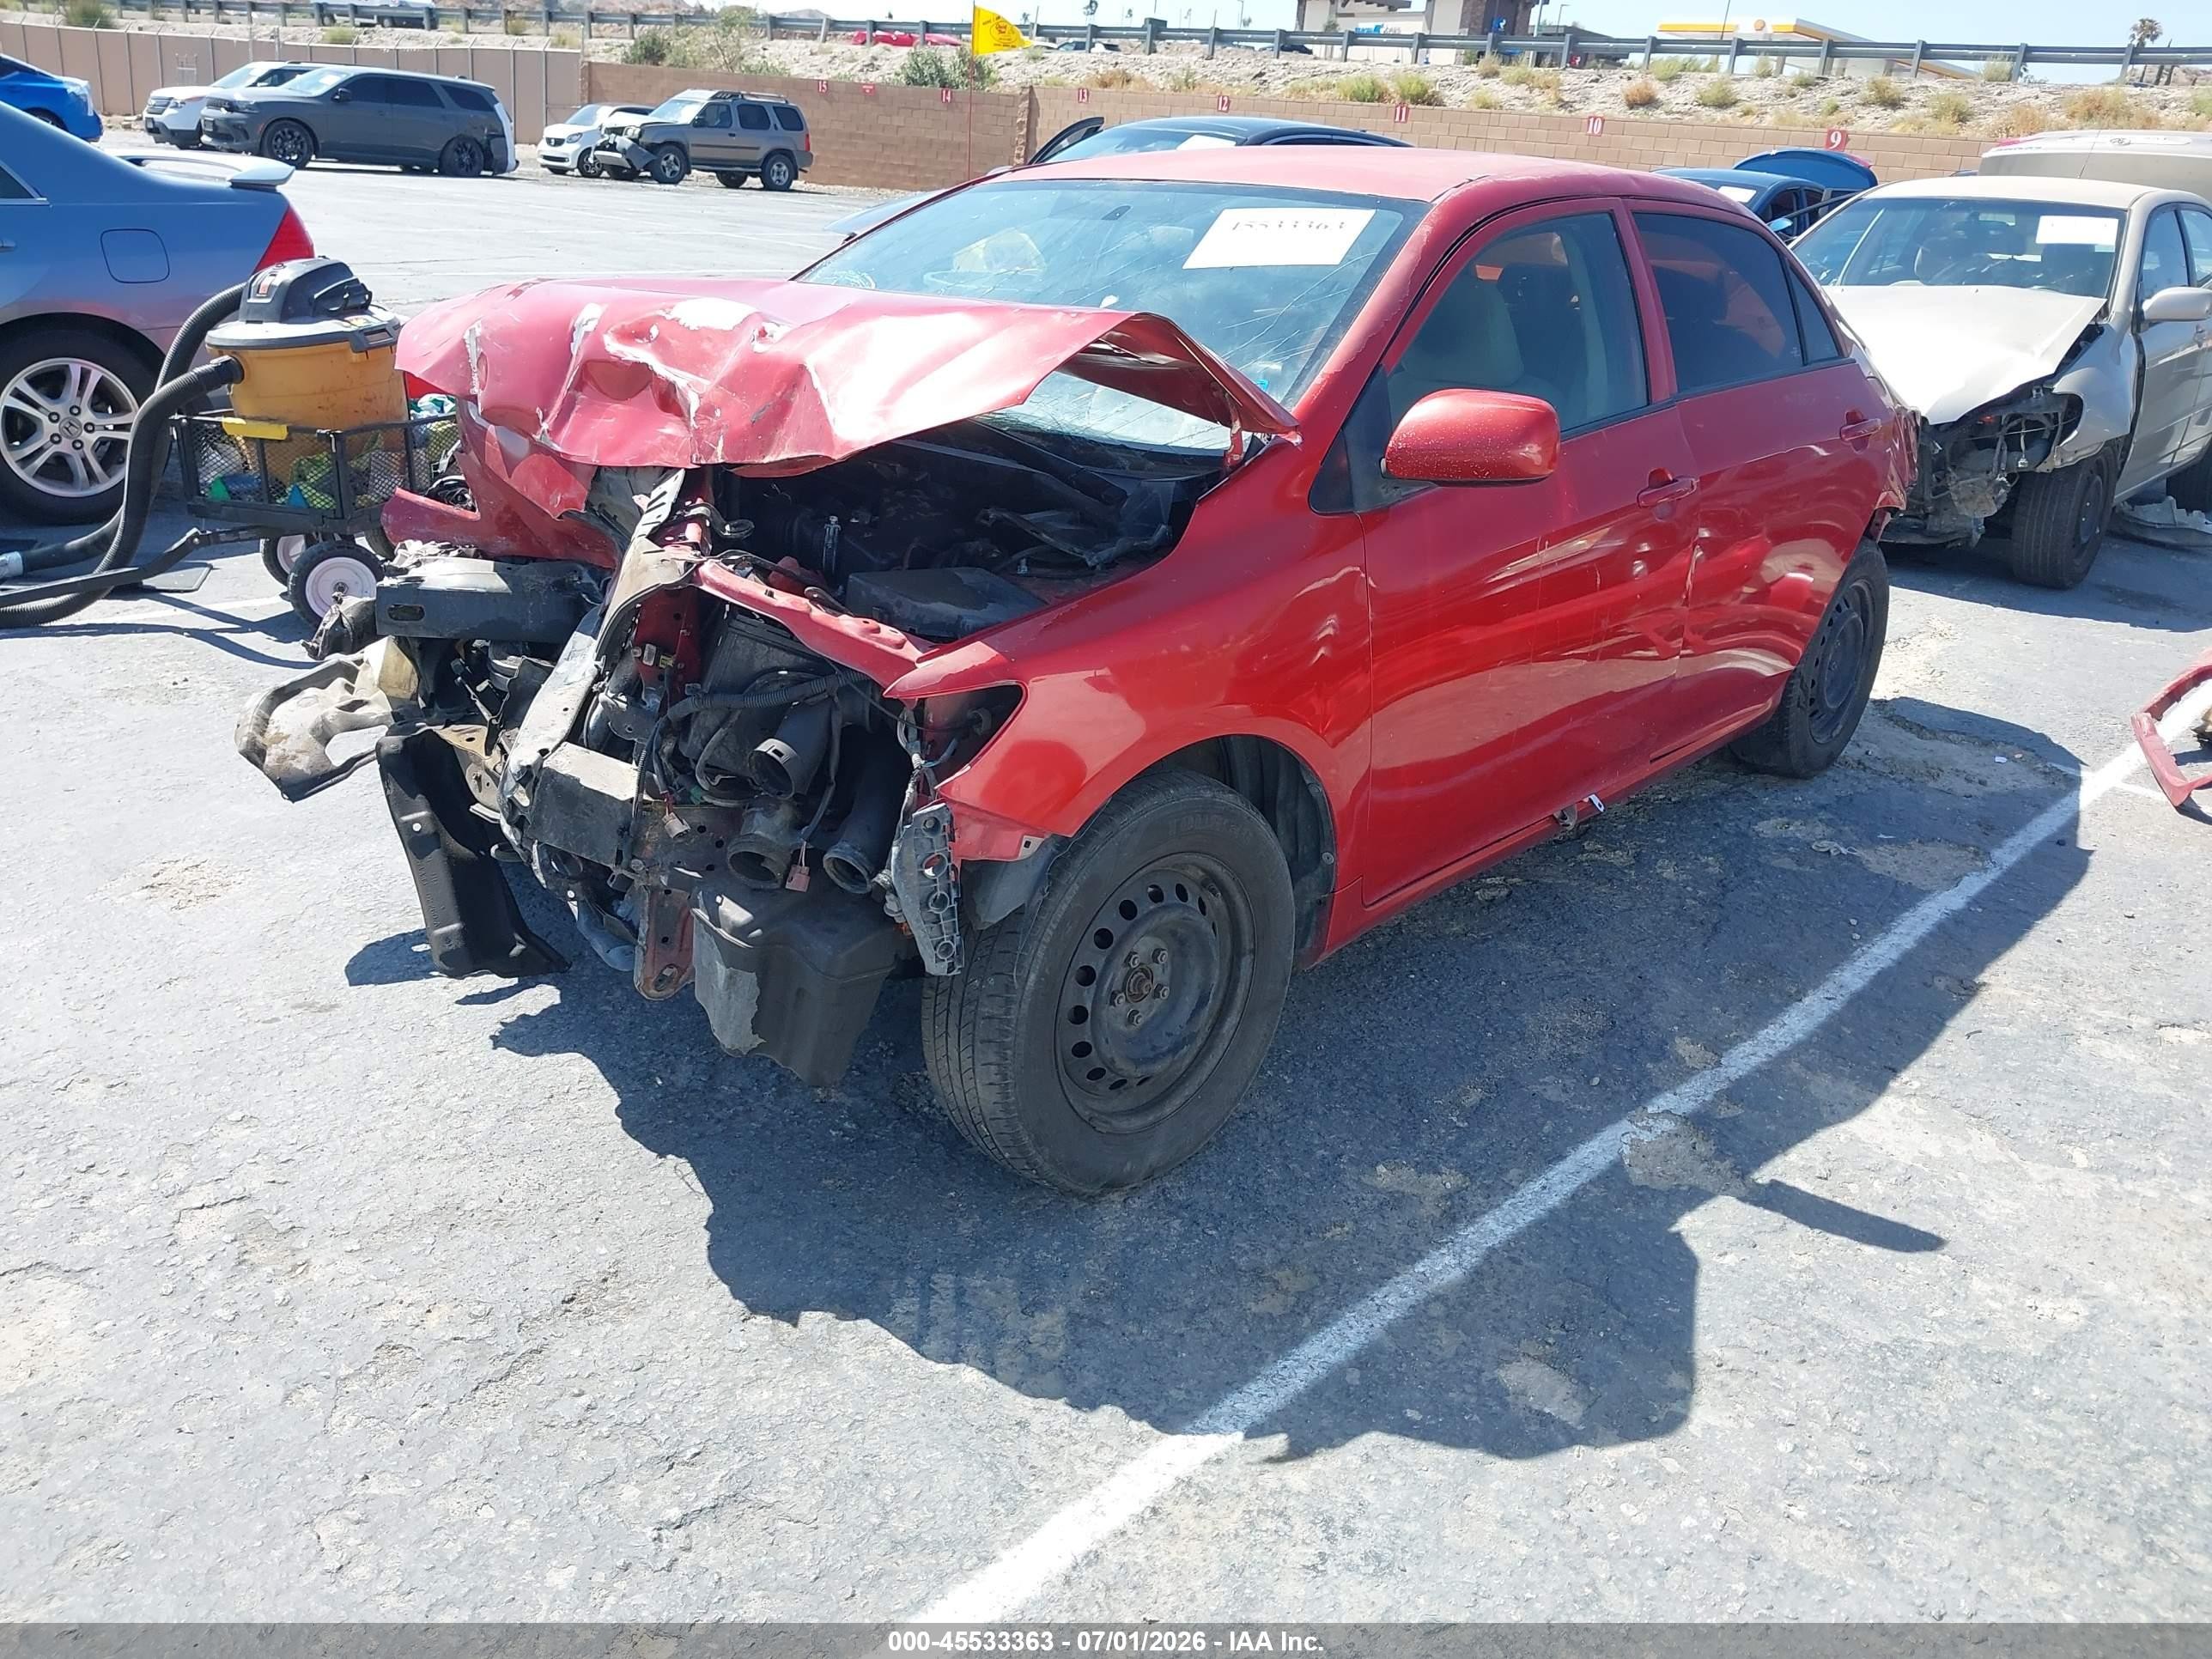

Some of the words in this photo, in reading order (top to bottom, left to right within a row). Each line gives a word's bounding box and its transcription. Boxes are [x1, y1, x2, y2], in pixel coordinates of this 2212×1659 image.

[818, 80, 828, 93] 15
[1079, 88, 1088, 102] 13
[1218, 95, 1229, 111] 12
[1395, 105, 1407, 122] 11
[1587, 117, 1602, 135] 10
[1829, 131, 1842, 149] 9
